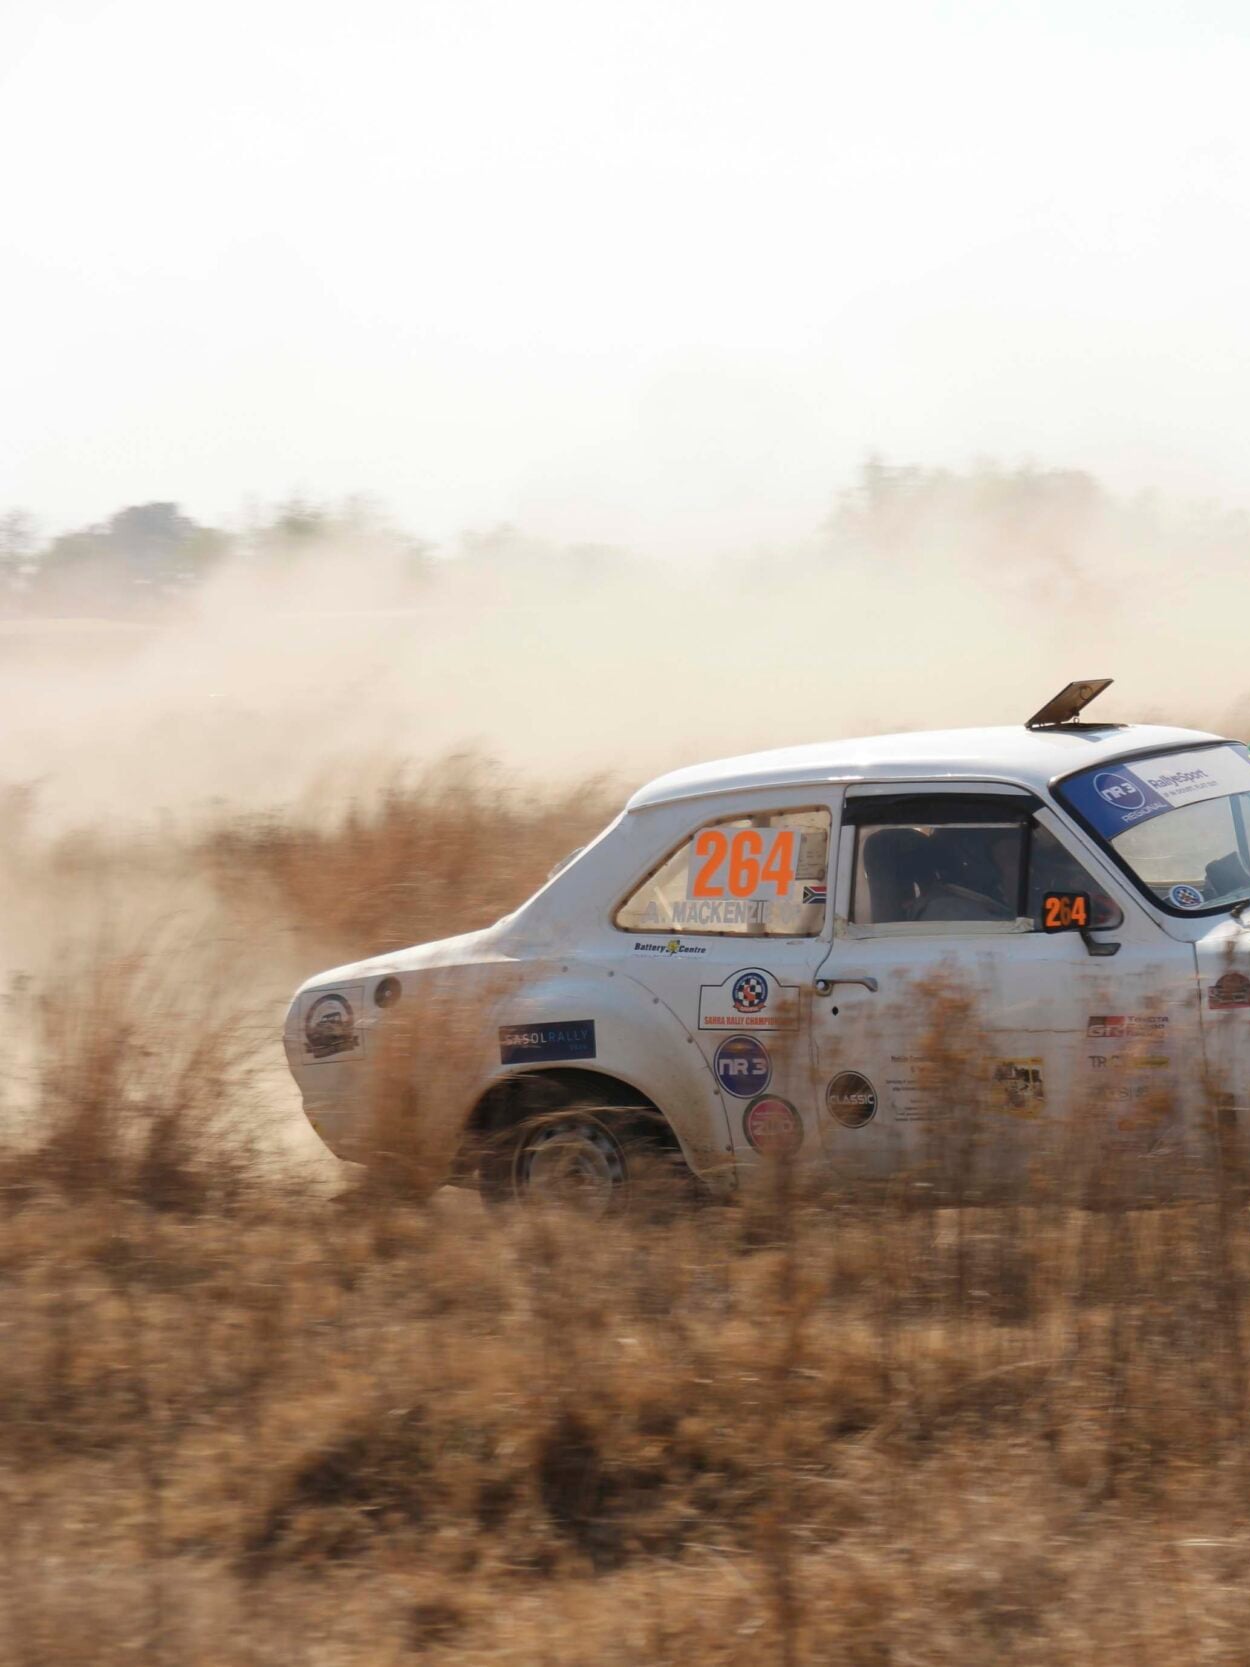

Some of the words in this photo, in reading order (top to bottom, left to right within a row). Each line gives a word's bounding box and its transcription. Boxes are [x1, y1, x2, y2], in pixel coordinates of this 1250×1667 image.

[692, 830, 796, 898] 264
[1045, 896, 1087, 927] 264
[634, 942, 666, 953] Battery
[678, 944, 707, 954] Centre
[829, 1094, 874, 1105] CLASSIC
